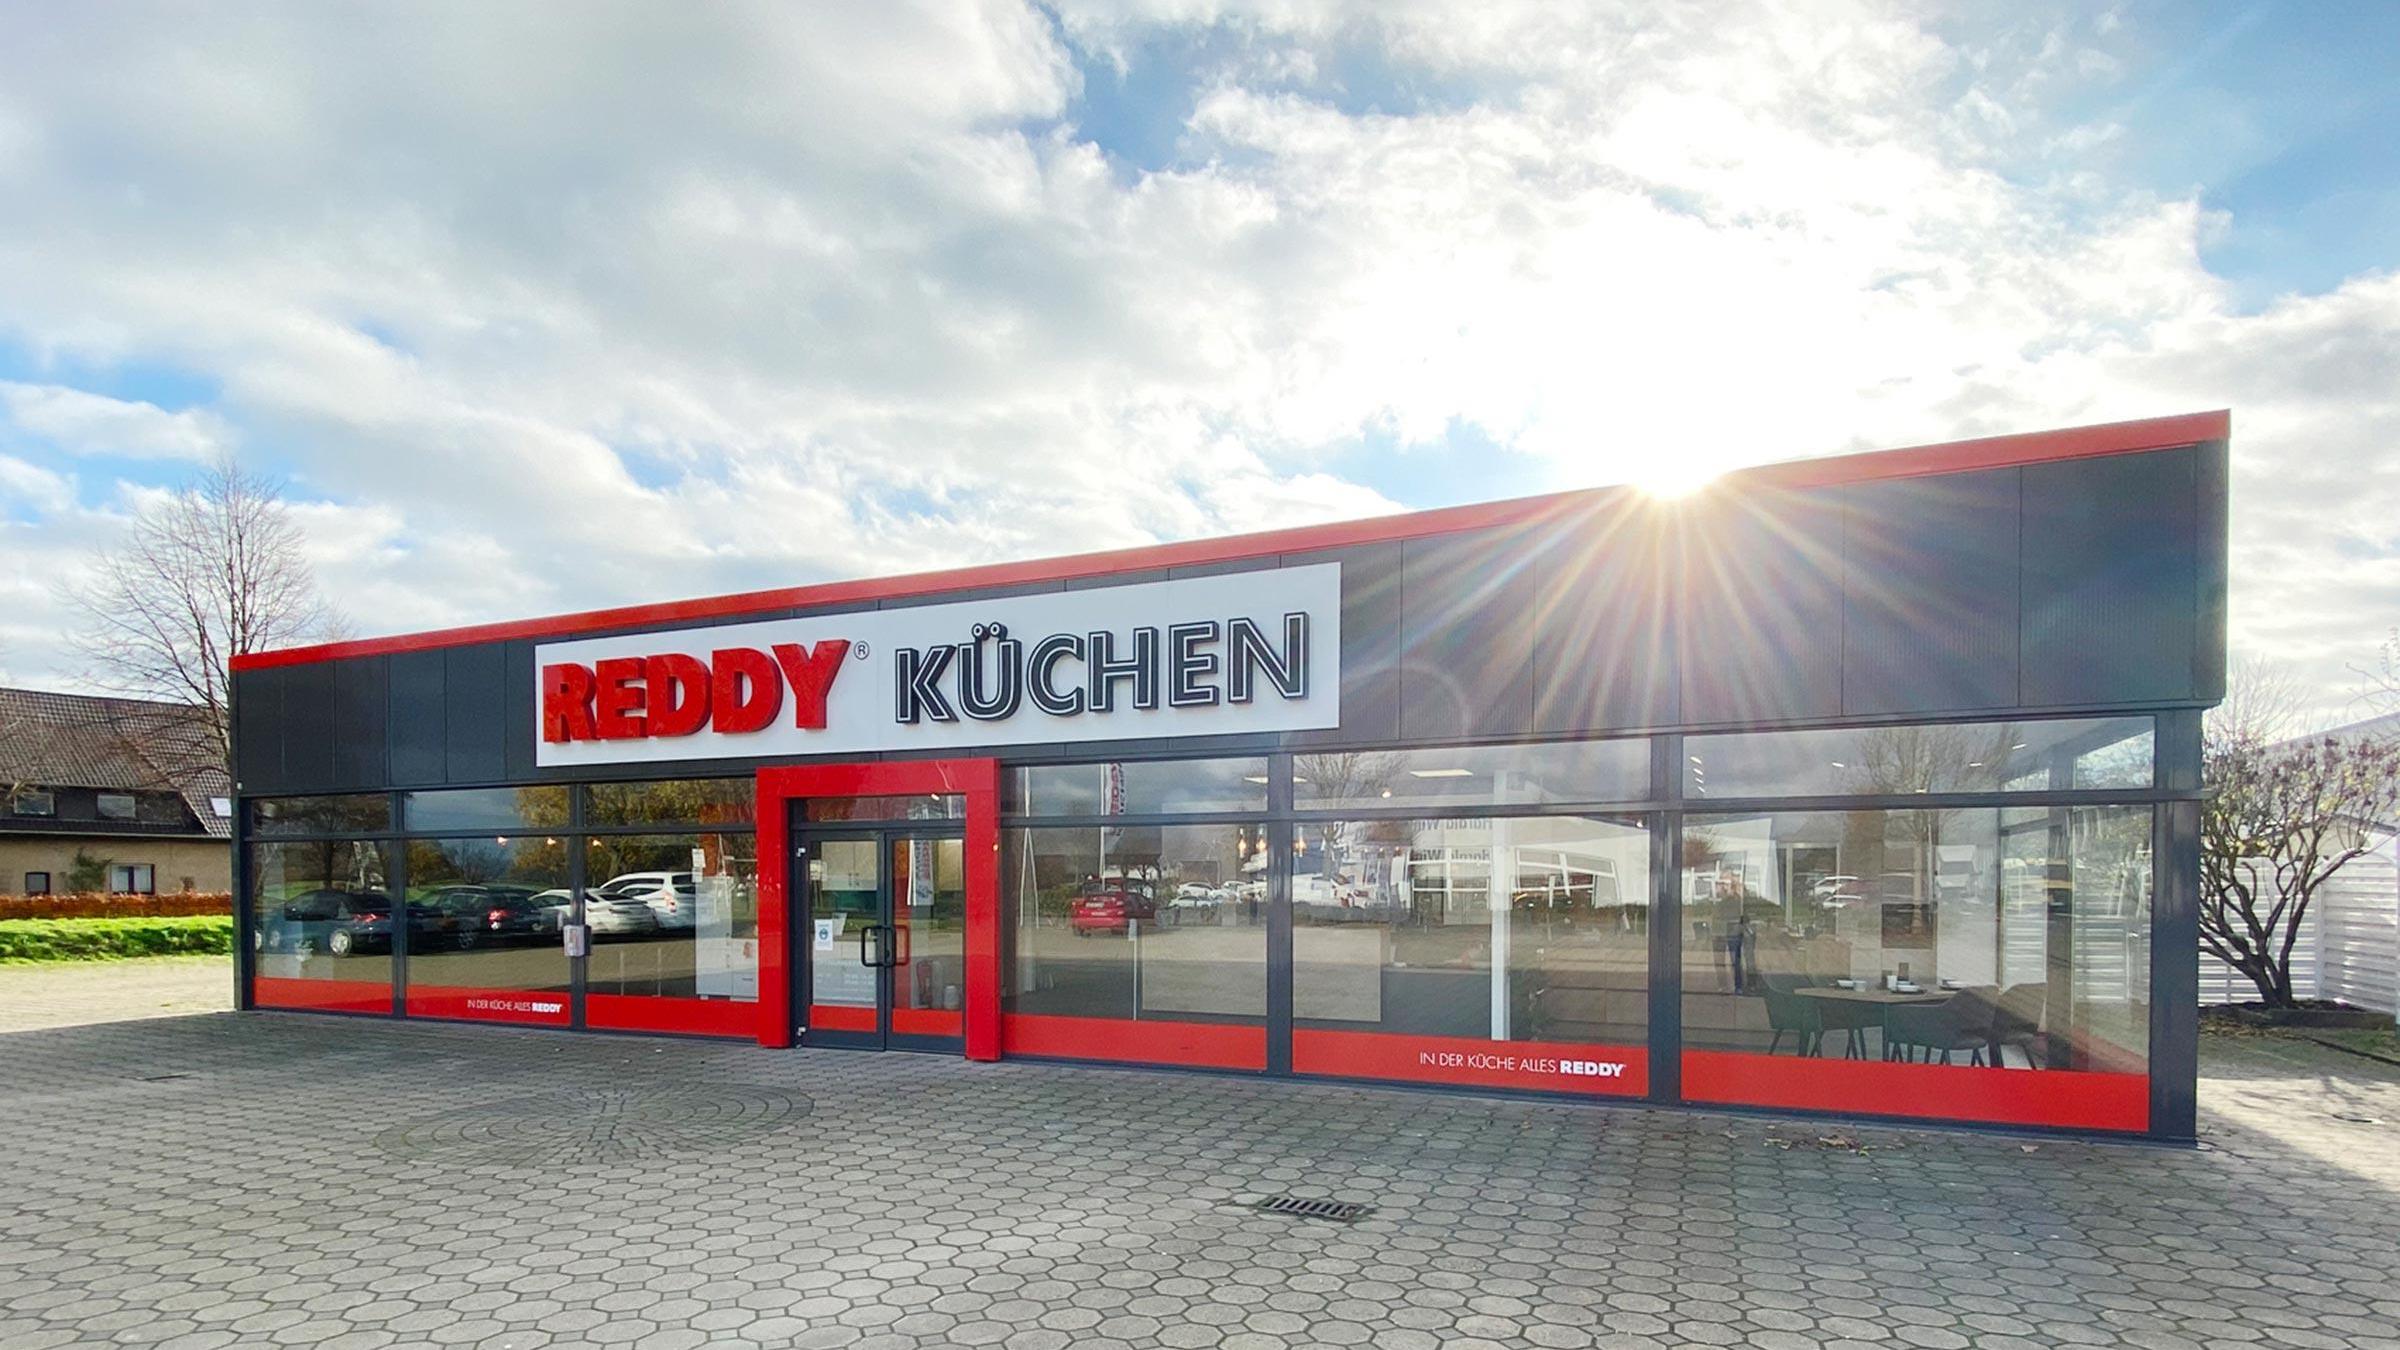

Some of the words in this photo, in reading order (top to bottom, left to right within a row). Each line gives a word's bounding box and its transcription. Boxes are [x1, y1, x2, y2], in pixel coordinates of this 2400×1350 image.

[543, 639, 850, 743] REDDY
[895, 611, 1309, 723] KÜCHEN
[532, 1002, 562, 1013] REDDY
[1420, 1052, 1435, 1065] IN
[1439, 1053, 1463, 1067] DER
[1467, 1053, 1515, 1071] KÜCHE
[1519, 1059, 1556, 1073] ALLES
[1560, 1060, 1624, 1077] REDDY
